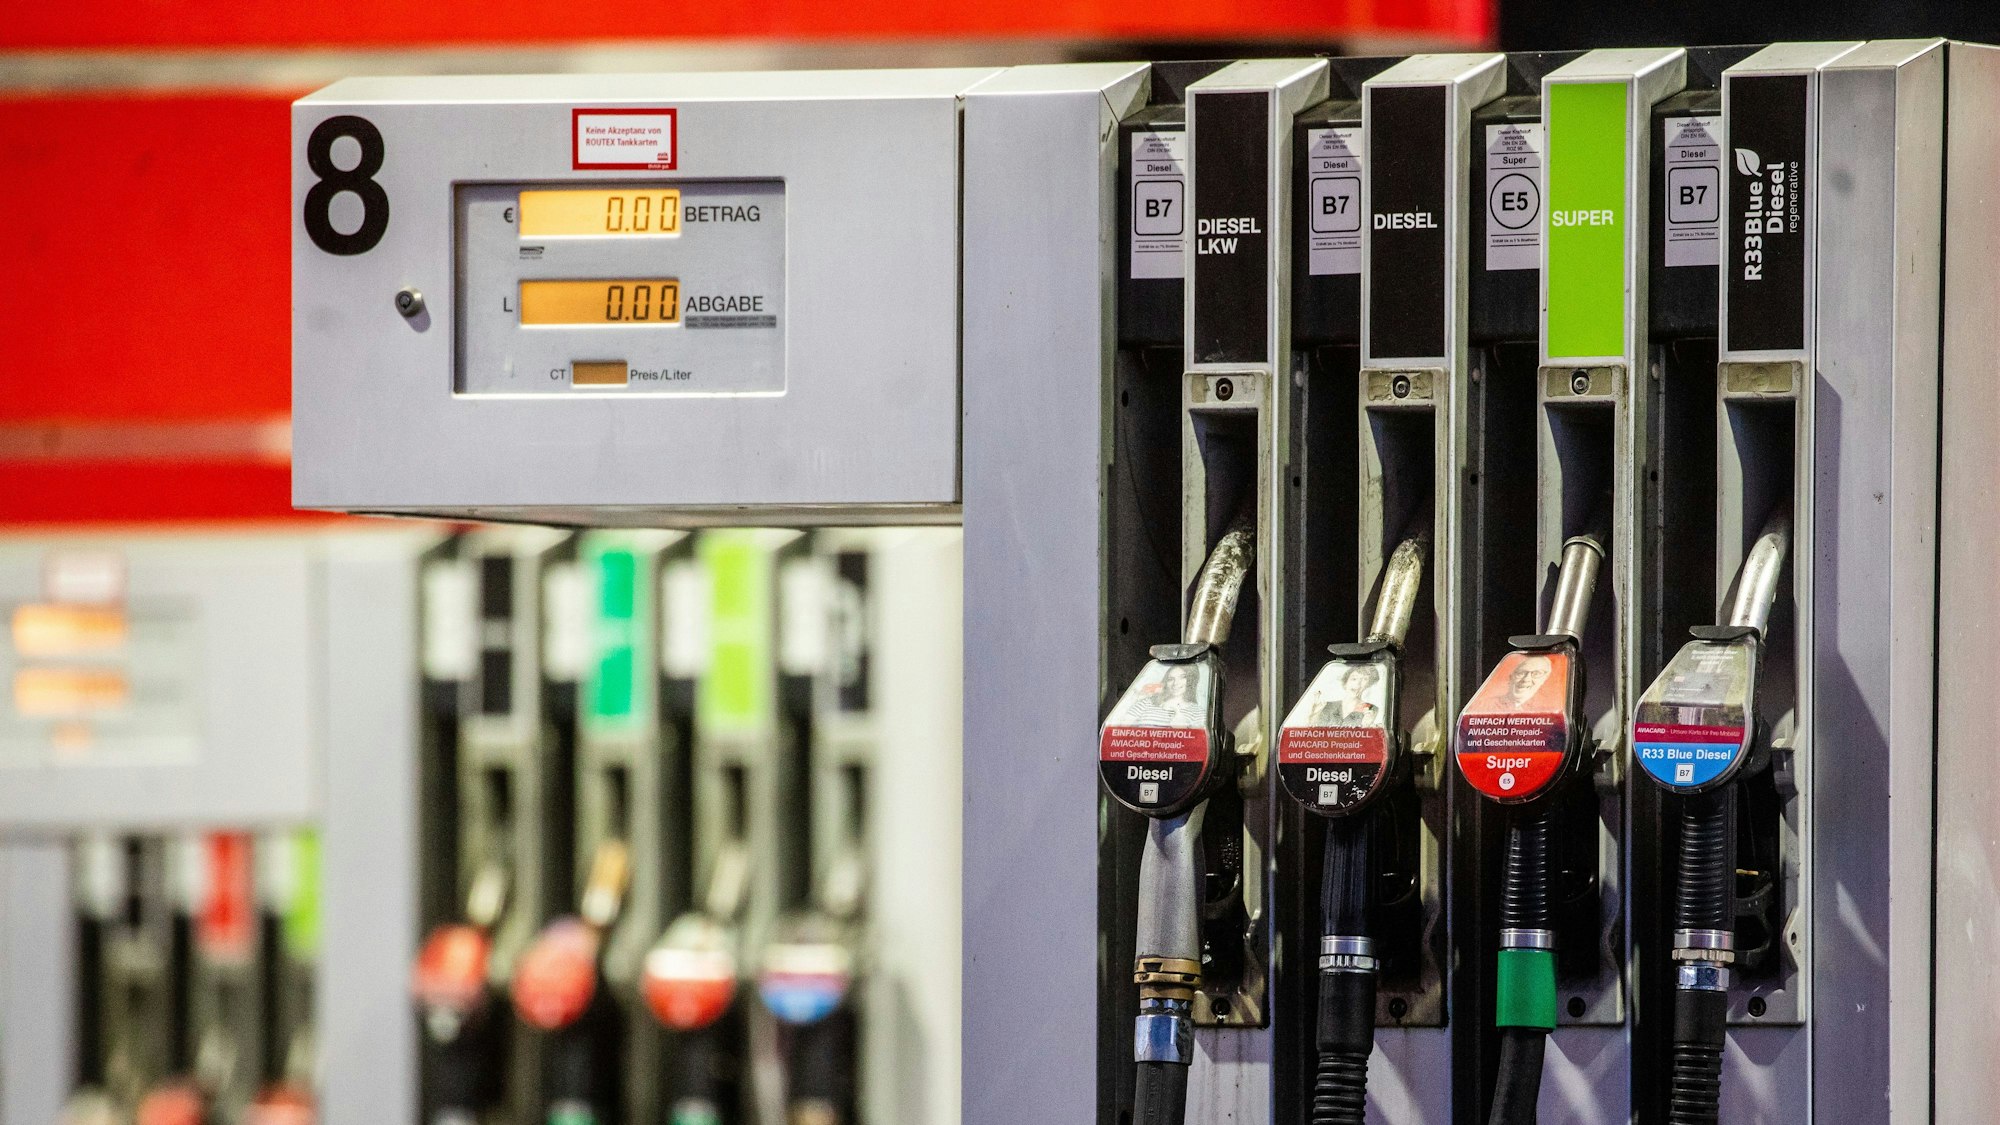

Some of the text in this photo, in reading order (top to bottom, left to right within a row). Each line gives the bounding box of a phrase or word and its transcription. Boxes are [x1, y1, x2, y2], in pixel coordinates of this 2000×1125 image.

[608, 127, 646, 136] Akzeptanz
[586, 138, 658, 146] ROUTEX Tankkarten
[1502, 156, 1526, 165] Super
[1681, 150, 1706, 158] Diesel
[1147, 164, 1172, 172] Diesel
[303, 115, 390, 256] 8
[1501, 192, 1528, 211] E5
[1680, 185, 1708, 205] B7
[1765, 162, 1785, 234] Diesel
[1788, 161, 1800, 233] regenerative
[1146, 199, 1173, 218] B7
[1322, 196, 1350, 214] B7
[503, 207, 514, 223] €
[606, 196, 678, 232] 0.00
[685, 206, 760, 222] BETRAG
[1374, 212, 1438, 229] DIESEL
[1552, 210, 1614, 227] SUPER
[1198, 218, 1261, 235] DIESEL
[1198, 238, 1238, 254] LKW
[503, 297, 513, 312] L
[606, 285, 678, 321] 0.00
[686, 296, 763, 312] ABGABE
[550, 370, 565, 380] CT
[1112, 729, 1147, 737] EINFACH
[1468, 728, 1543, 736] AVIACARD Prepaid-
[1110, 740, 1184, 750] AVIACARD Prepaid-
[1331, 741, 1363, 750] Prepaid-
[1126, 751, 1186, 760] Geschenkkarten
[1304, 751, 1365, 759] Geschenkkarten
[1642, 749, 1731, 760] R33 Blue Diesel
[1486, 755, 1531, 772] Super
[1127, 766, 1173, 780] Diesel
[1306, 768, 1352, 782] Diesel
